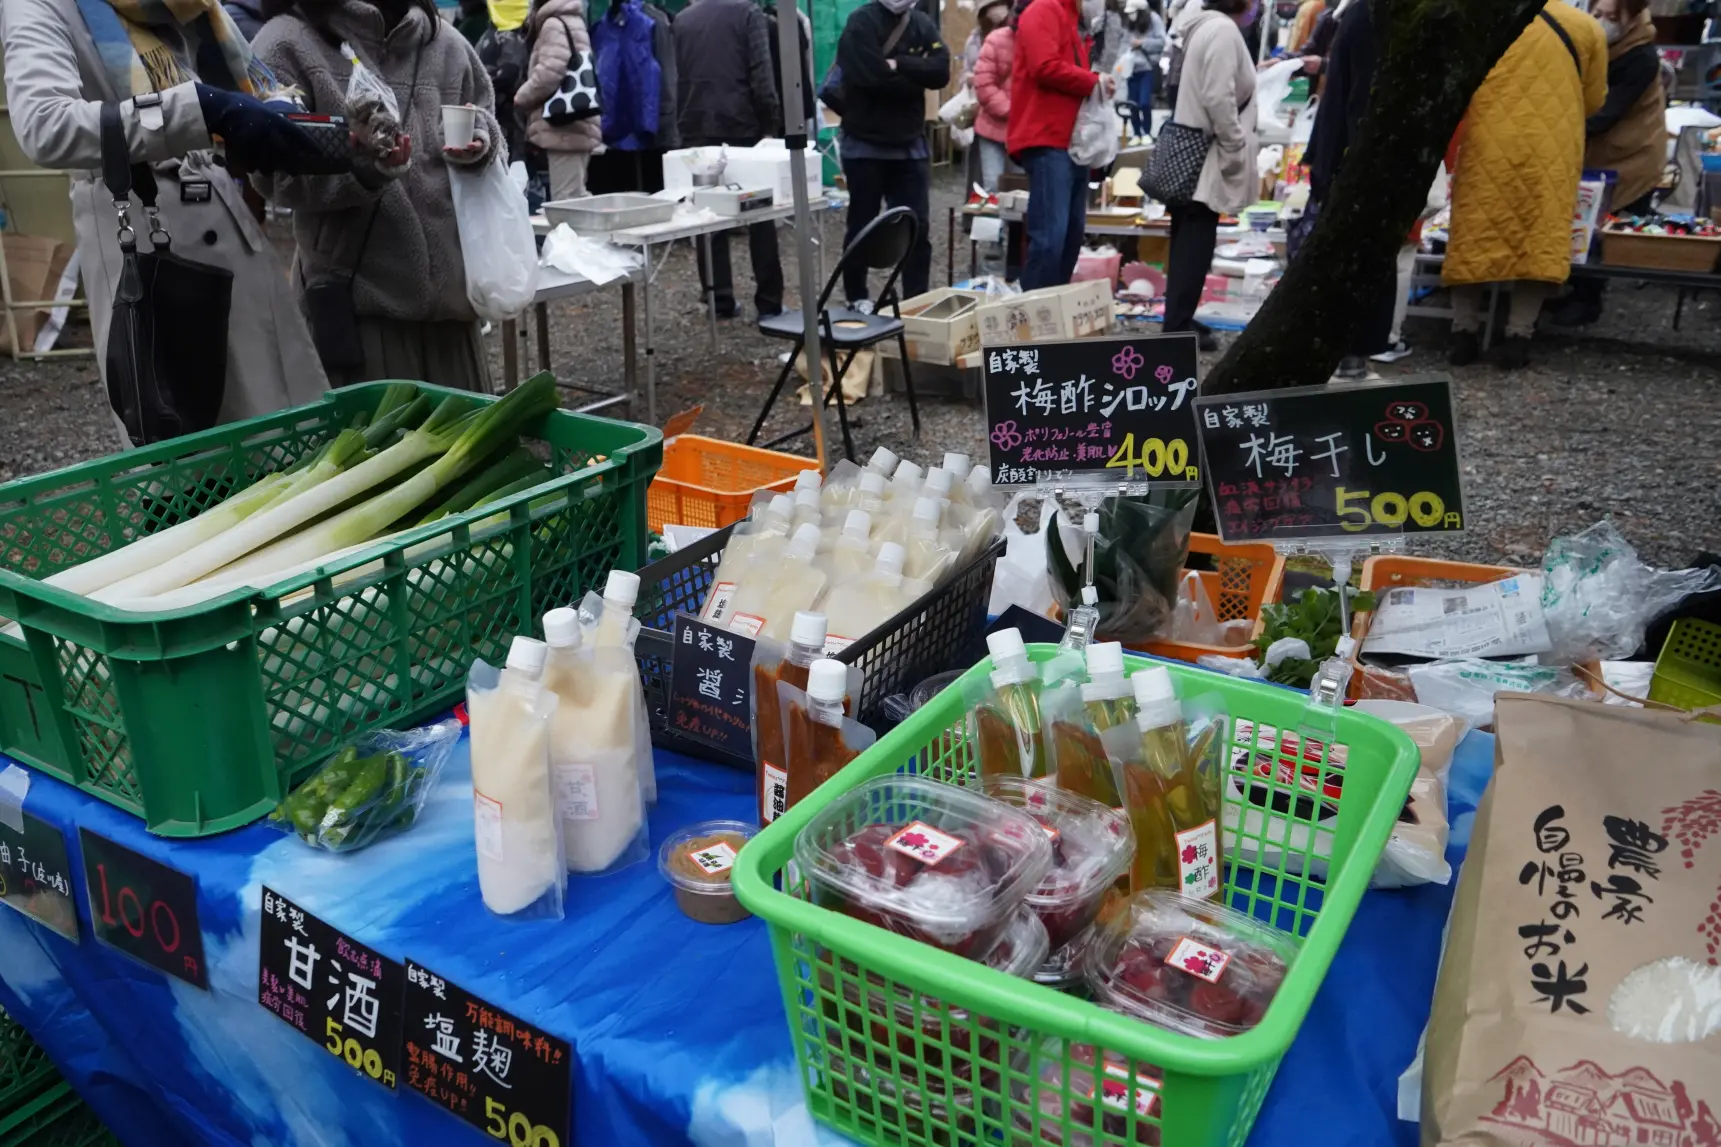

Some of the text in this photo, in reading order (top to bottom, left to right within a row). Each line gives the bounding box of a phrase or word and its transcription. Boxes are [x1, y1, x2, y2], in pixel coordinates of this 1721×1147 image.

[989, 348, 1041, 376] 自家製
[1010, 373, 1198, 418] 梅酢シロップ
[1203, 402, 1271, 428] 自家製
[1023, 420, 1113, 443] ポリフェノール豊富
[1239, 431, 1387, 478] 梅干し
[1105, 432, 1199, 481] 400円
[1335, 486, 1462, 532] 500円
[682, 625, 735, 662] 自家製
[1193, 842, 1210, 882] 梅酢
[1590, 814, 1670, 926] 農家
[264, 891, 309, 937] 自家製
[1517, 804, 1593, 1015] 自慢のお米
[335, 936, 383, 980] 飲む点滴
[284, 936, 381, 1039] 甘酒
[407, 963, 447, 1001] 自家製
[326, 1015, 396, 1089] 500円
[423, 1012, 513, 1089] 塩麹
